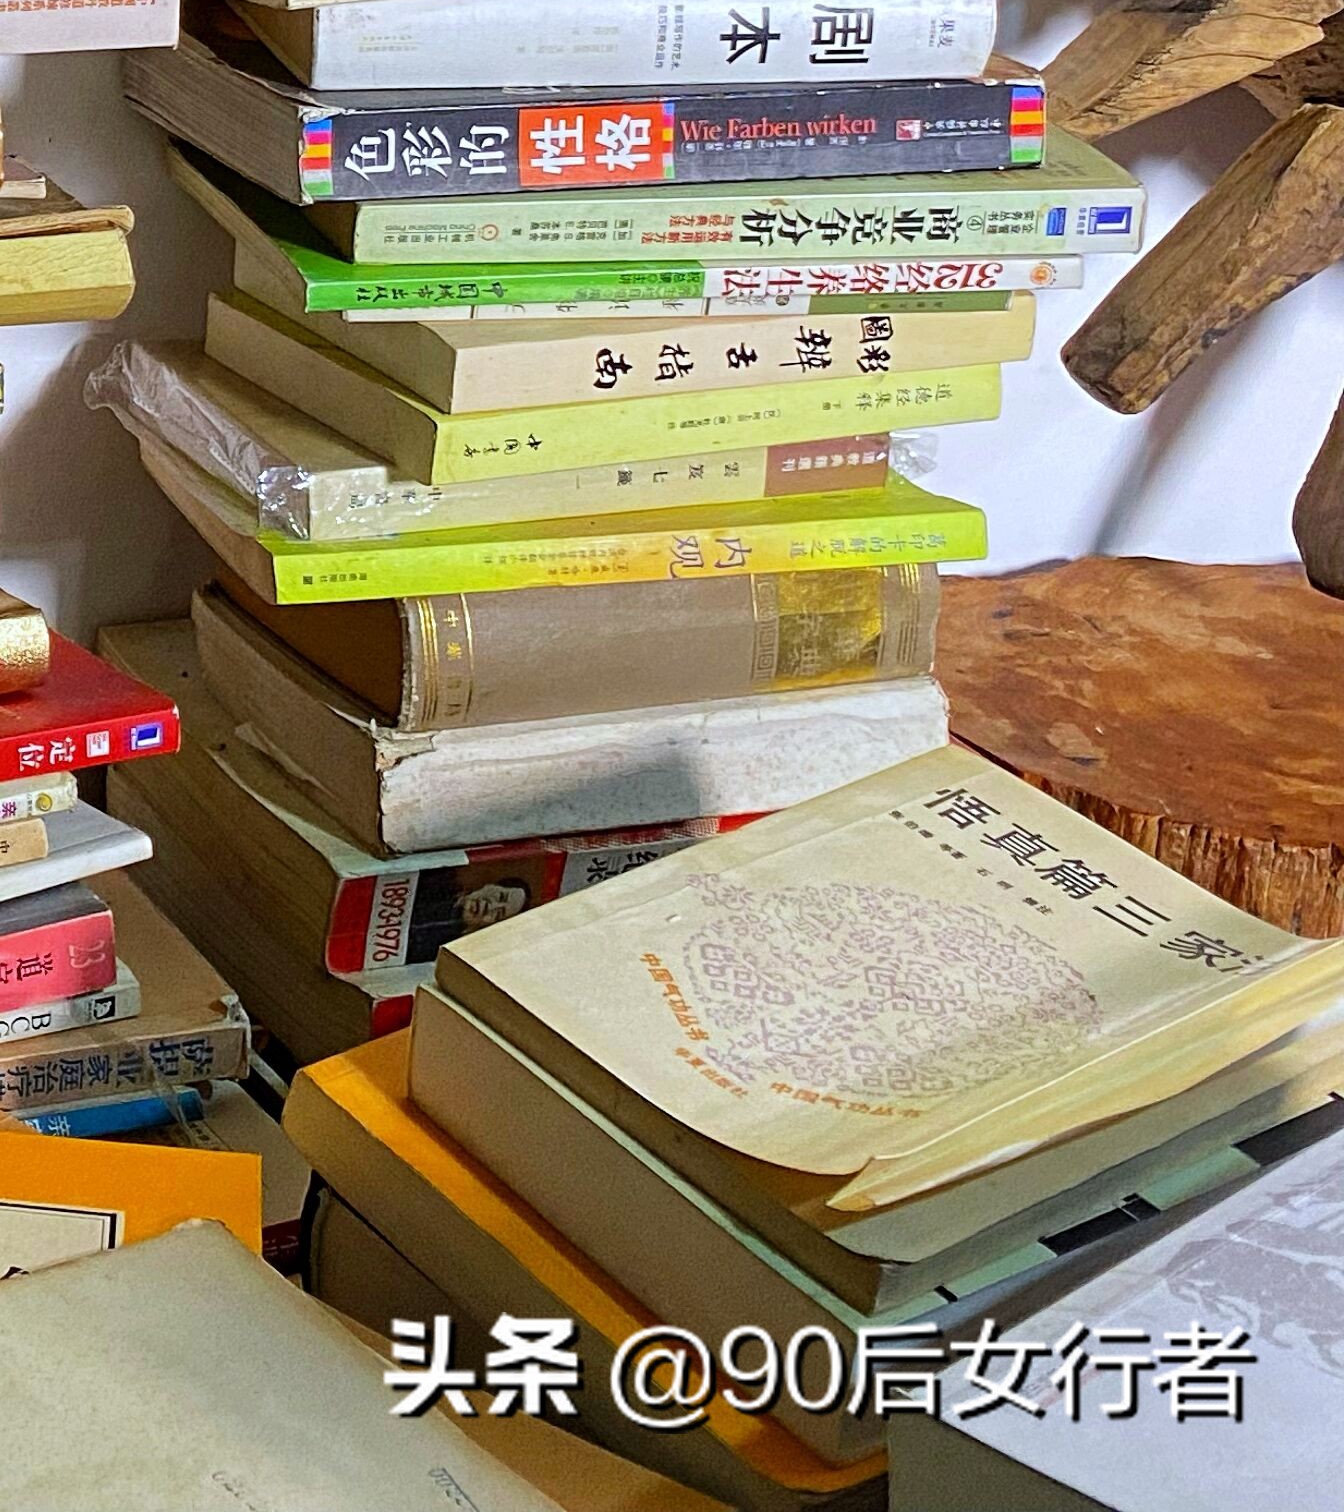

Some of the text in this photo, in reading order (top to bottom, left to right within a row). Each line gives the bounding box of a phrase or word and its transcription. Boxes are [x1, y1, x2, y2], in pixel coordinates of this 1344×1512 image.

[725, 5, 876, 67] 剧本
[342, 112, 877, 179] 色彩的 性格 Wie Farben wirken
[741, 208, 962, 246] 商业竞争分析
[669, 534, 753, 581] 内观
[17, 736, 85, 769] 定位
